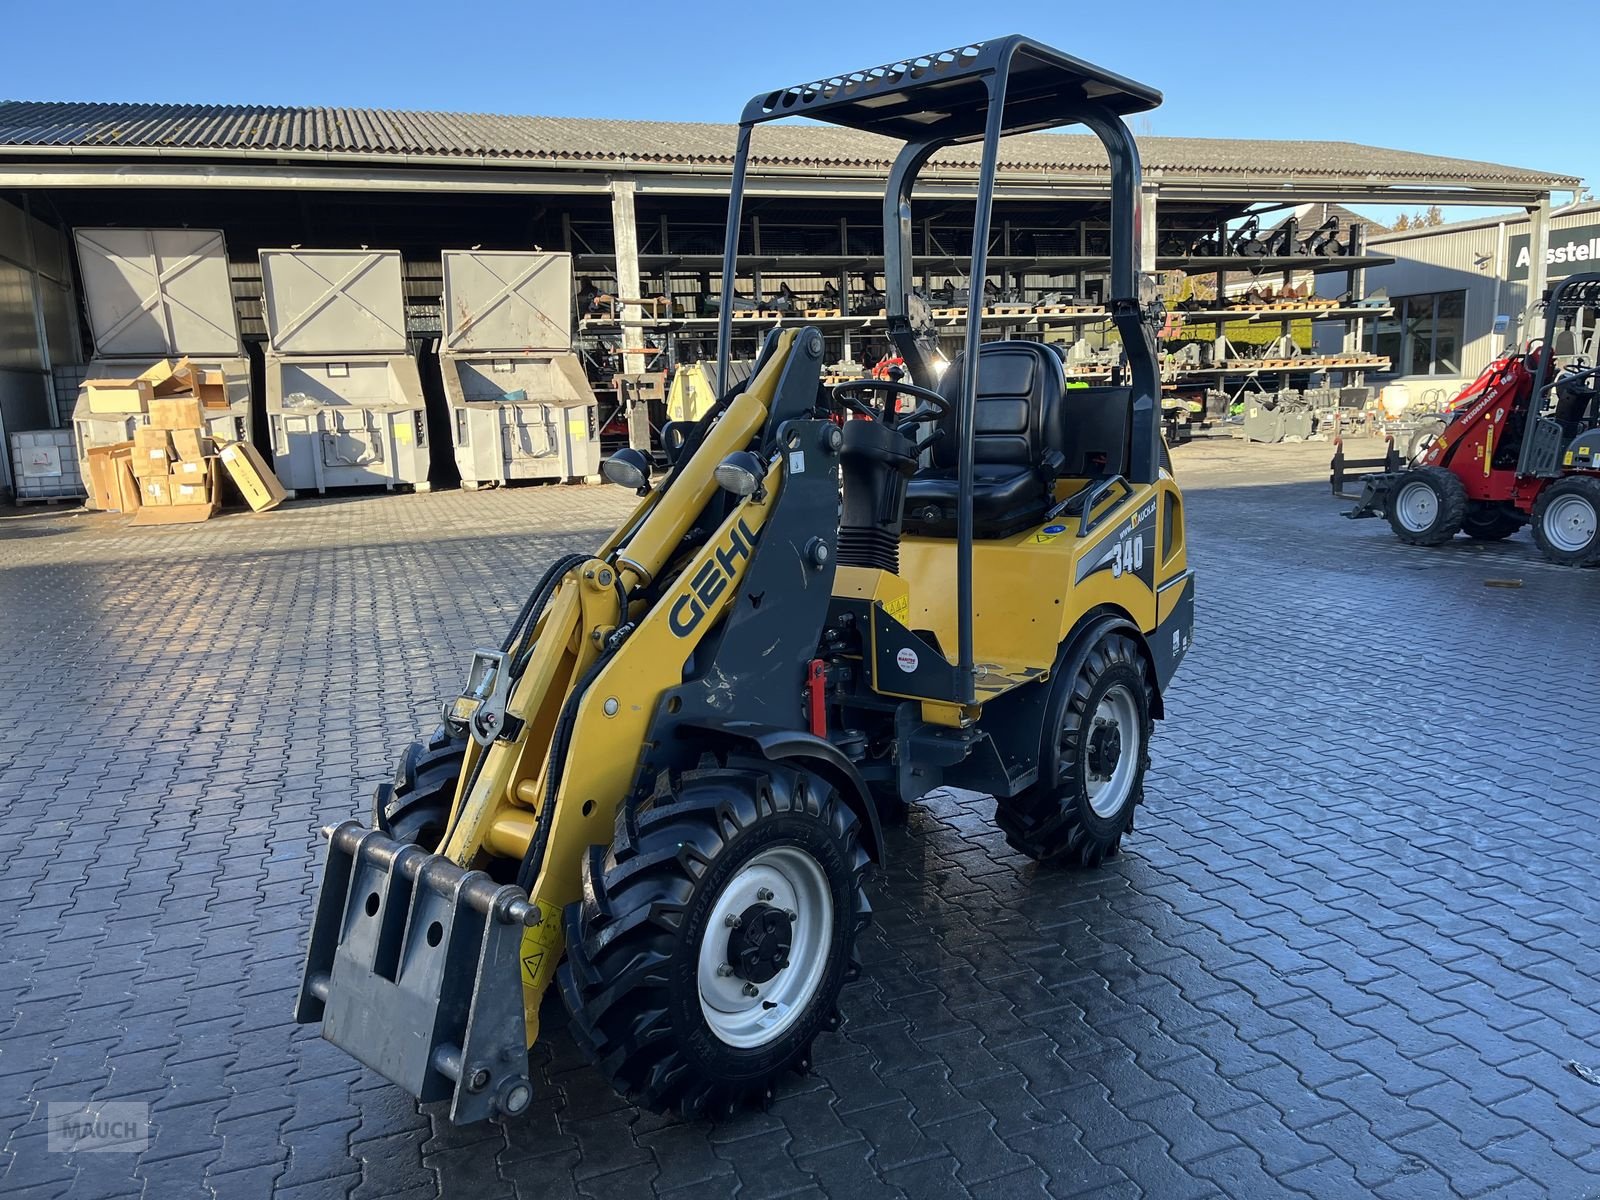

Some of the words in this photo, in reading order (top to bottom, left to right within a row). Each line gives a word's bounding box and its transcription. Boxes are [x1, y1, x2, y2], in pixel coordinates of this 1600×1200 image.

[1515, 237, 1600, 268] Asstell
[1461, 389, 1498, 424] WEIDEMANN
[1111, 533, 1143, 578] 340
[668, 515, 767, 639] GEHL
